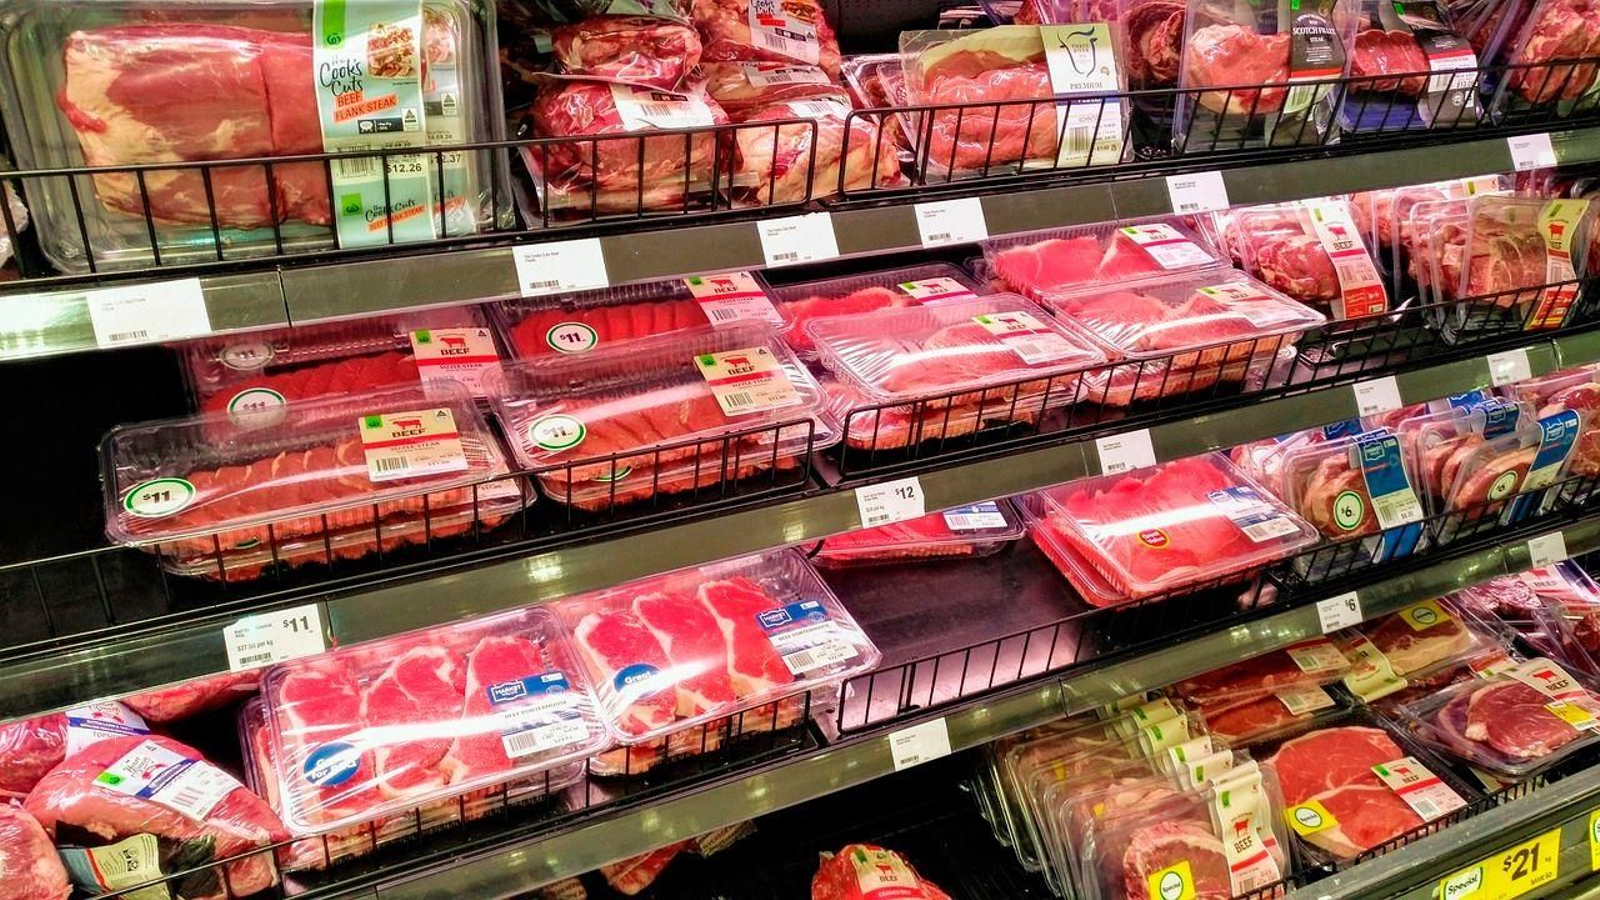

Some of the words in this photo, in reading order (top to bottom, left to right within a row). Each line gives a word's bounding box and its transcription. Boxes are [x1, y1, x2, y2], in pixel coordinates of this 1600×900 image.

[1292, 27, 1318, 35] SCOTCH
[320, 60, 362, 88] Cook's
[331, 77, 363, 97] Cuts
[1070, 82, 1102, 91] PREMIUM
[337, 93, 361, 107] BEEF
[335, 104, 367, 121] FLANK
[367, 98, 397, 114] STEAK
[387, 162, 422, 173] $12.26
[395, 199, 416, 213] Cuts
[1333, 241, 1354, 250] BEEF
[559, 332, 581, 343] $11
[441, 347, 470, 355] BEEF
[728, 366, 755, 375] BEEF
[391, 429, 426, 438] BEEF
[143, 490, 171, 503] $11
[895, 485, 915, 500] $12
[1341, 505, 1352, 517] $6
[1345, 598, 1356, 611] $6
[283, 616, 309, 632] $11
[494, 684, 522, 694] MARKET
[1545, 679, 1570, 691] BEEF
[1402, 774, 1419, 784] BEEF
[1234, 835, 1253, 853] BEEF
[1502, 843, 1540, 881] $21
[1162, 883, 1181, 892] Special
[1448, 874, 1478, 895] Special
